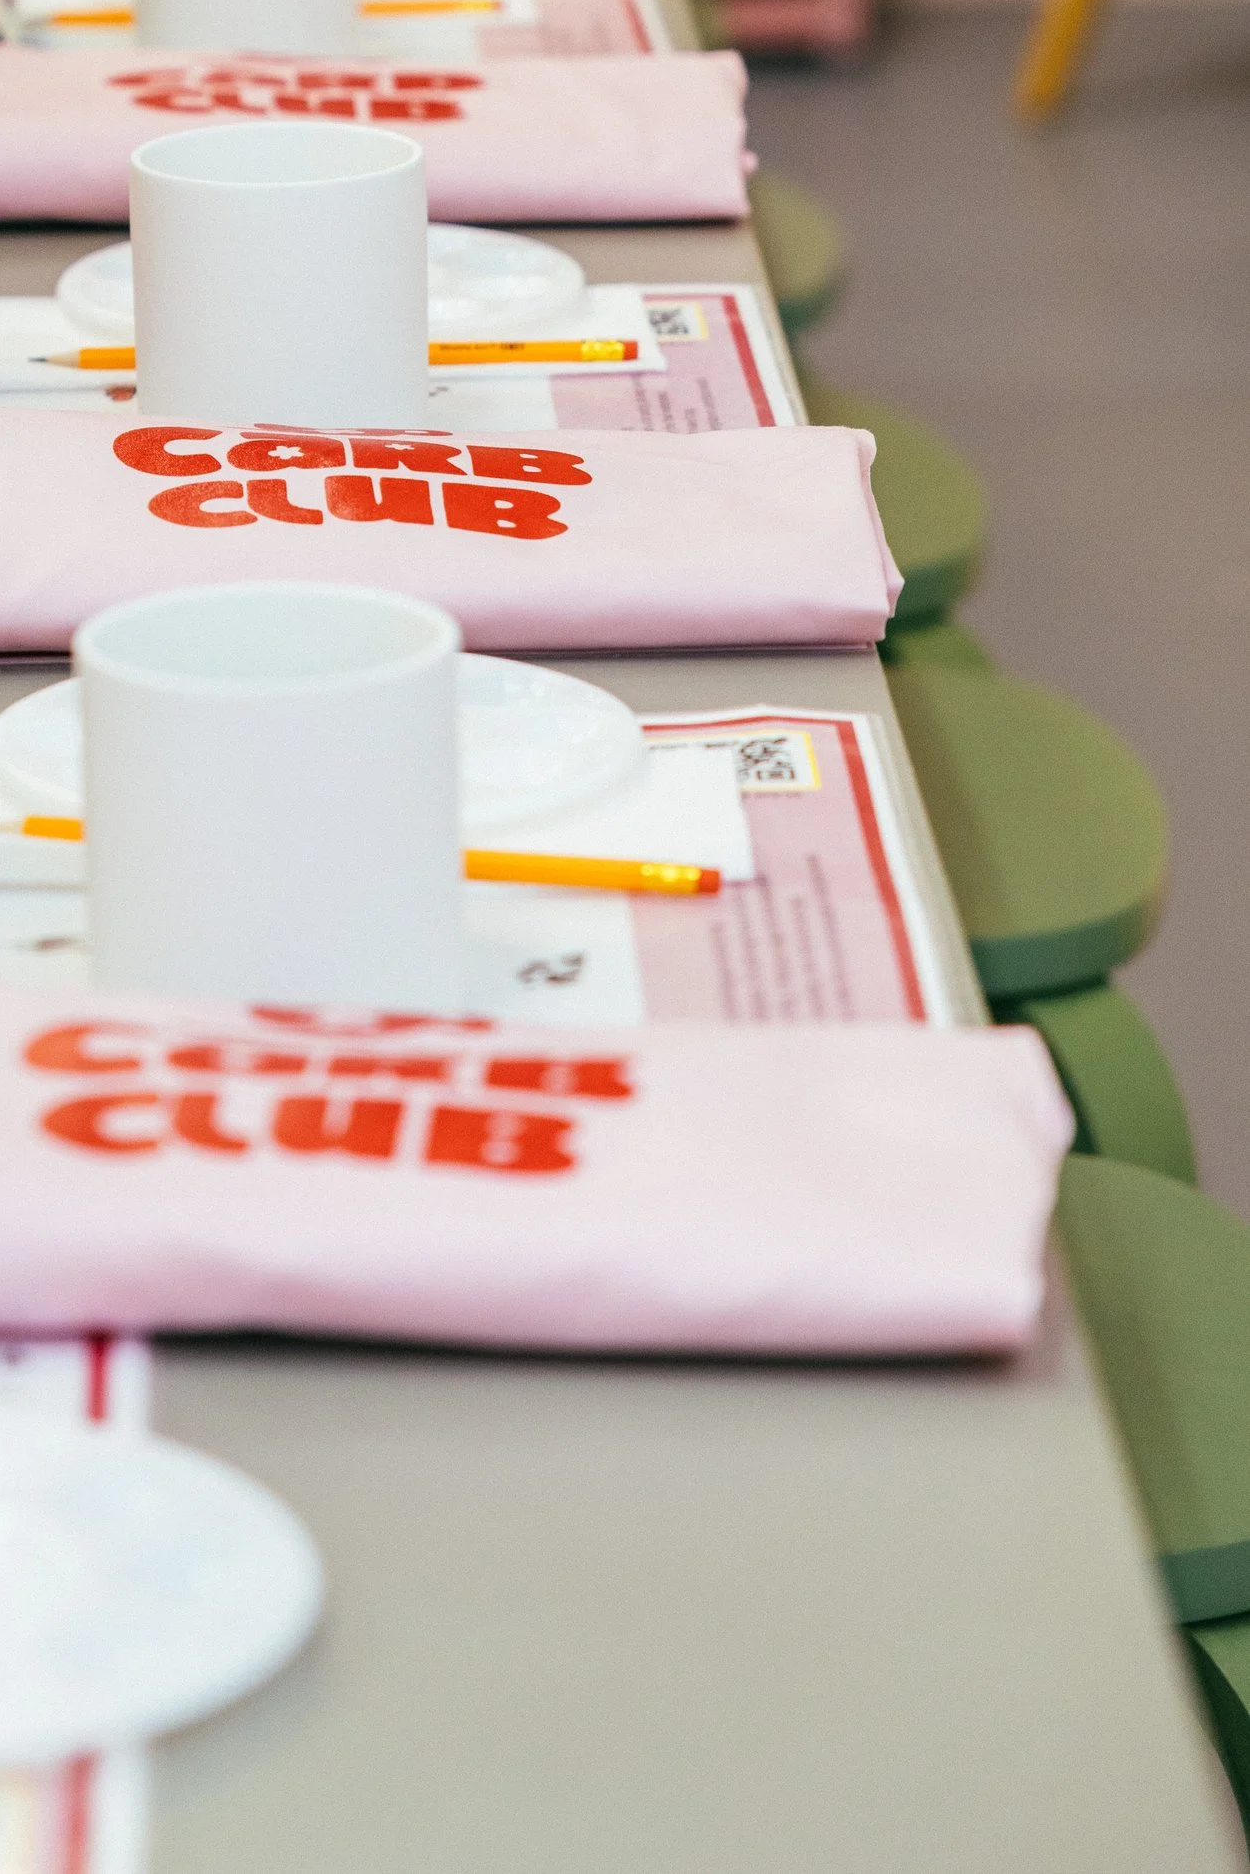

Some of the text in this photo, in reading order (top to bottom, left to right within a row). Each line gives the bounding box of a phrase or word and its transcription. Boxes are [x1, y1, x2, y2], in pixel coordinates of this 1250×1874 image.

[112, 425, 594, 486] CARB
[147, 474, 570, 540] CLUB
[24, 1022, 634, 1100] CARB
[42, 1092, 580, 1176] CLUB
